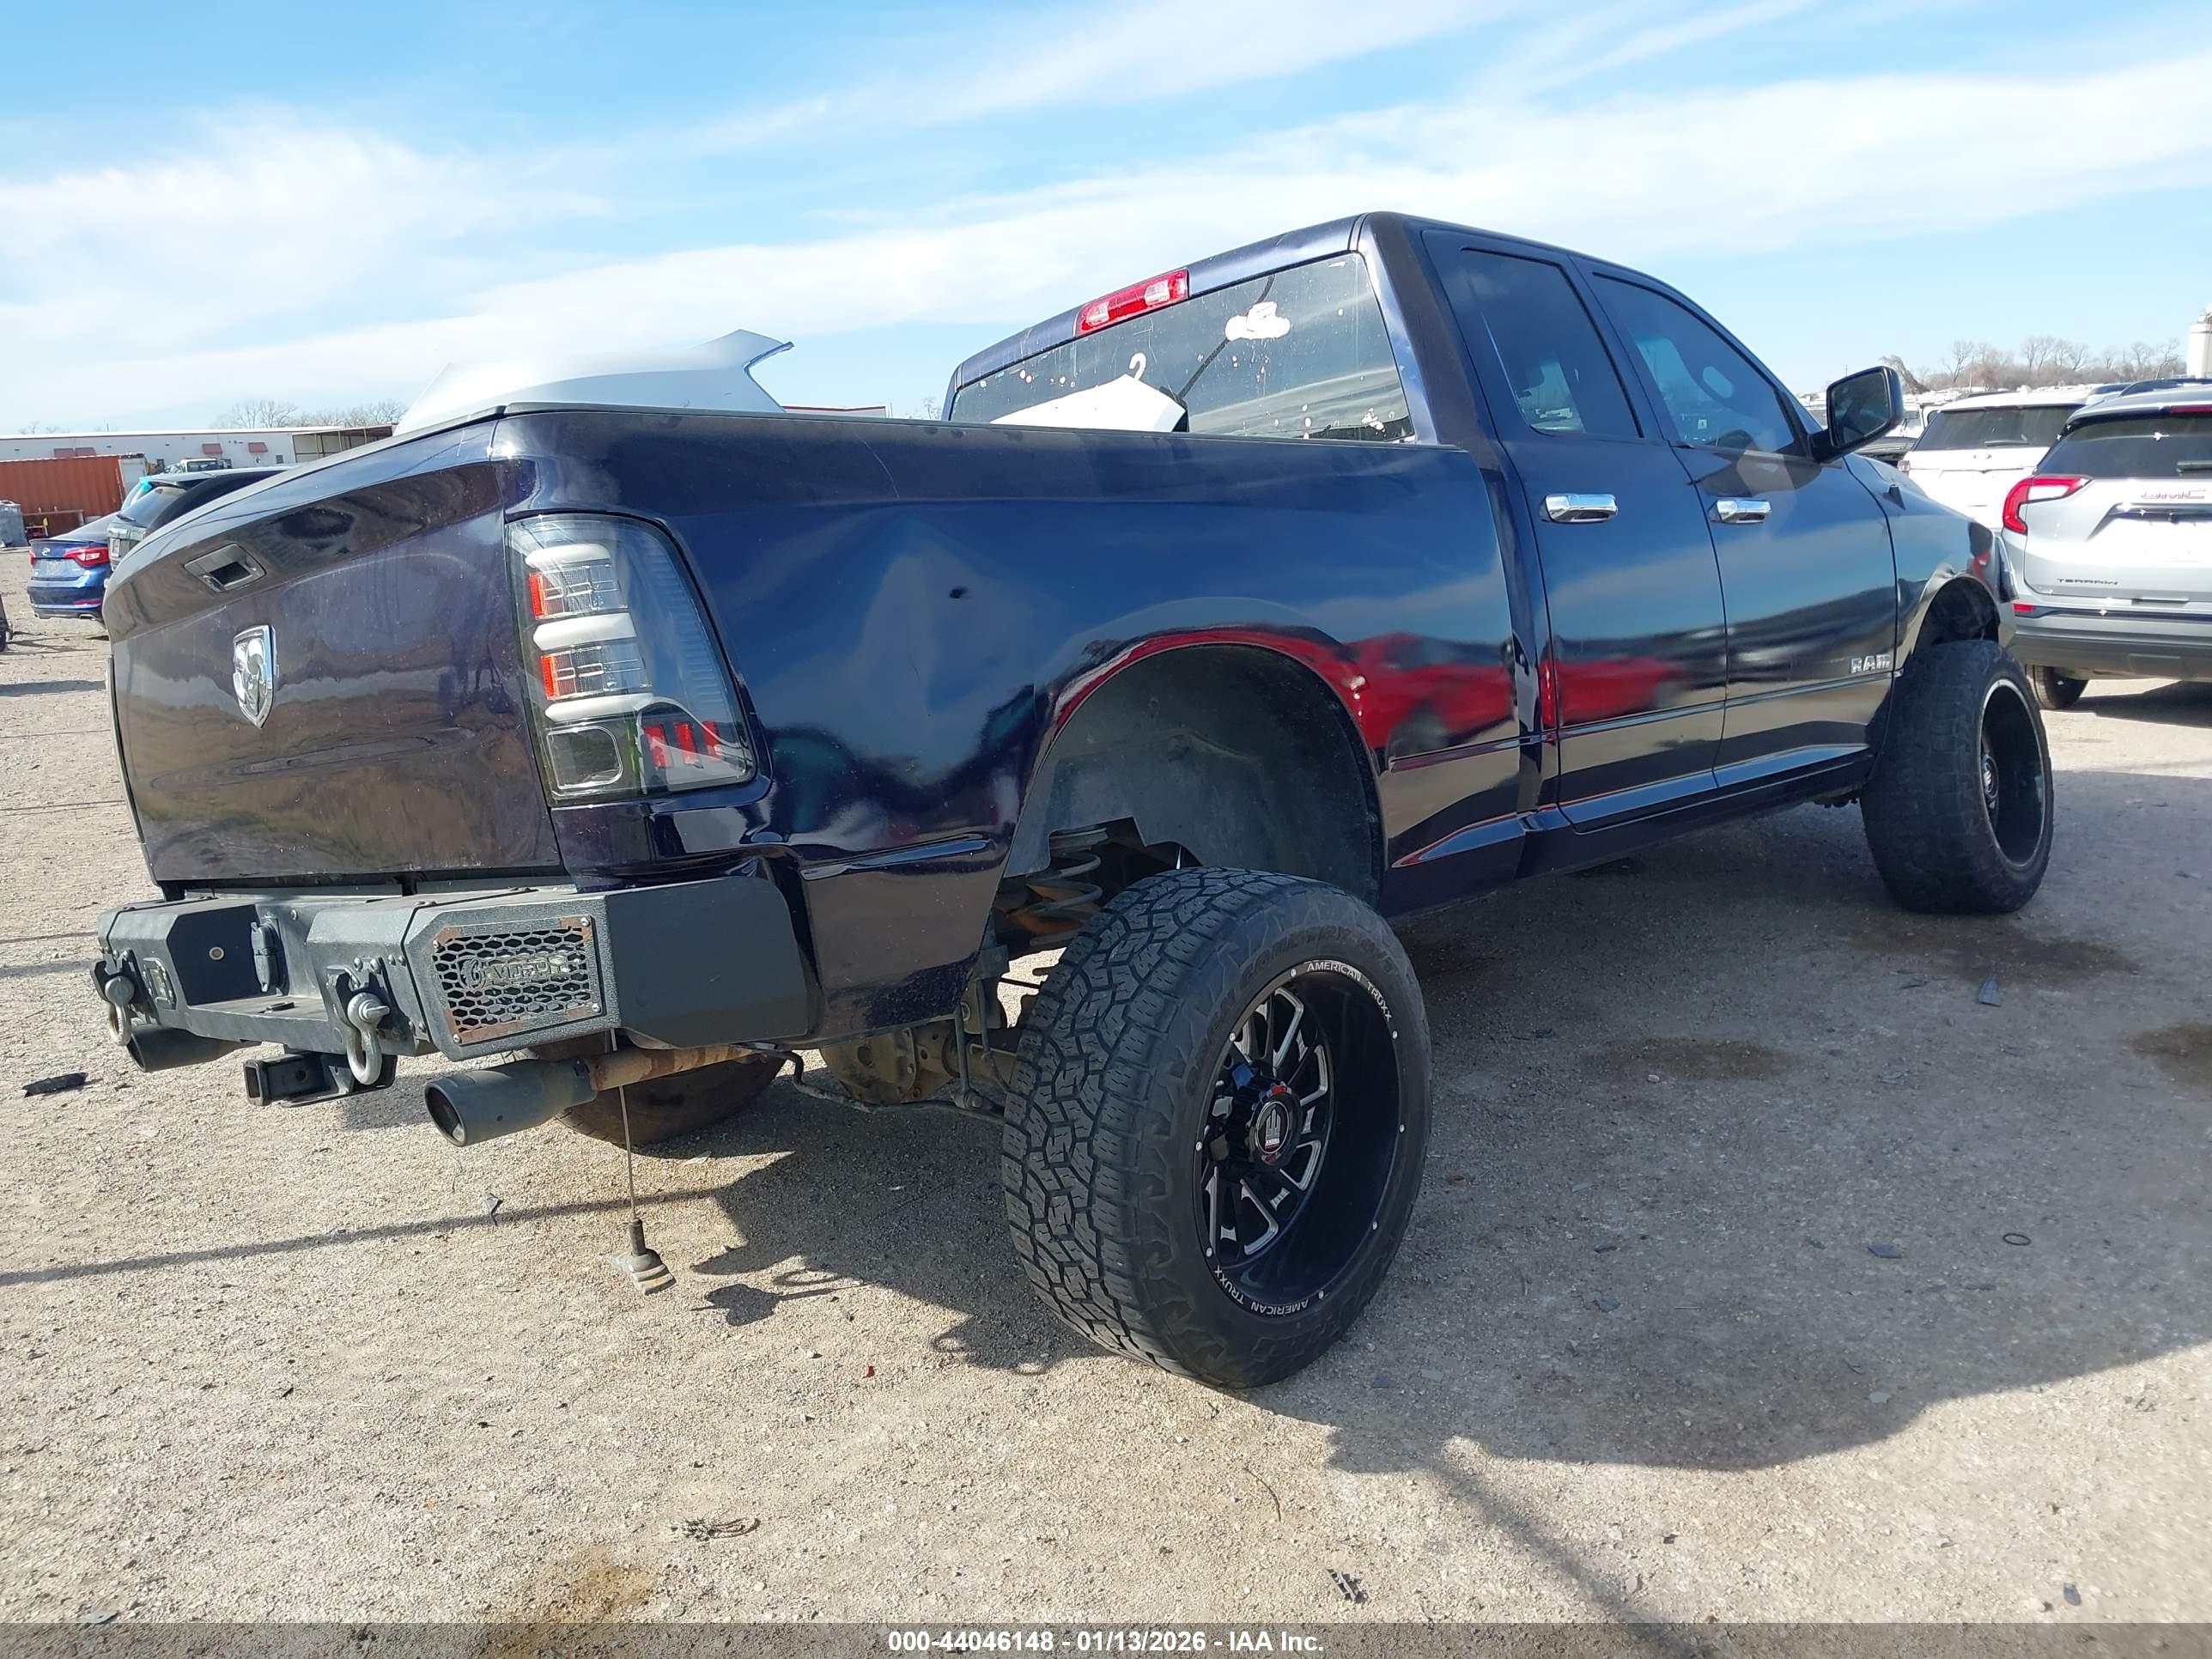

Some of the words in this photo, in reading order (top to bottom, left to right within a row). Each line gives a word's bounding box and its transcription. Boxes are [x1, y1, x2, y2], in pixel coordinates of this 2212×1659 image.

[1851, 654, 1890, 674] RAM
[1307, 961, 1362, 982] AMERICAN
[1366, 981, 1393, 1022] TRUXX
[1214, 1265, 1244, 1304] TRUXX
[1251, 1298, 1310, 1316] AMERICAN
